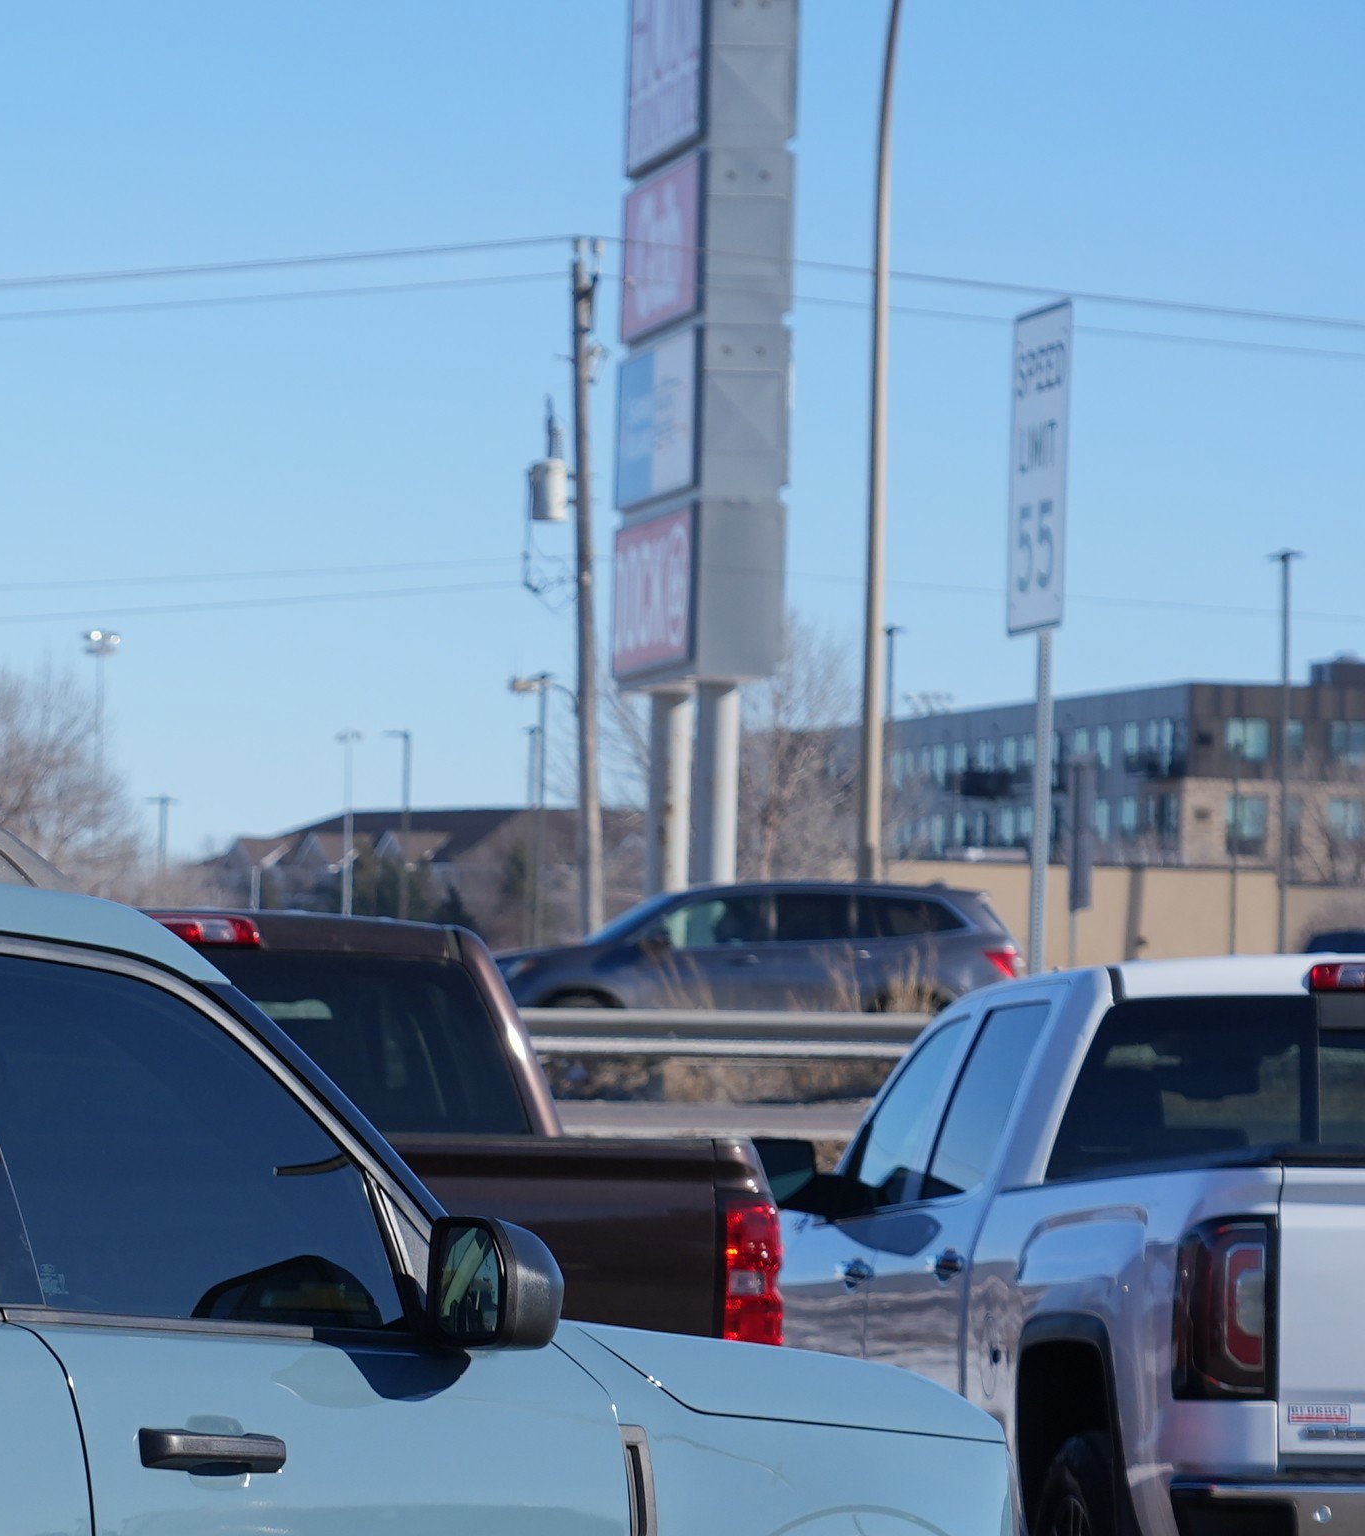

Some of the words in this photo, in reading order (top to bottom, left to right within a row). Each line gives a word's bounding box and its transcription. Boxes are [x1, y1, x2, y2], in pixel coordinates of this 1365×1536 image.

[1017, 341, 1067, 398] SPEED
[1018, 417, 1059, 475] LIMIT
[1017, 498, 1055, 593] 55
